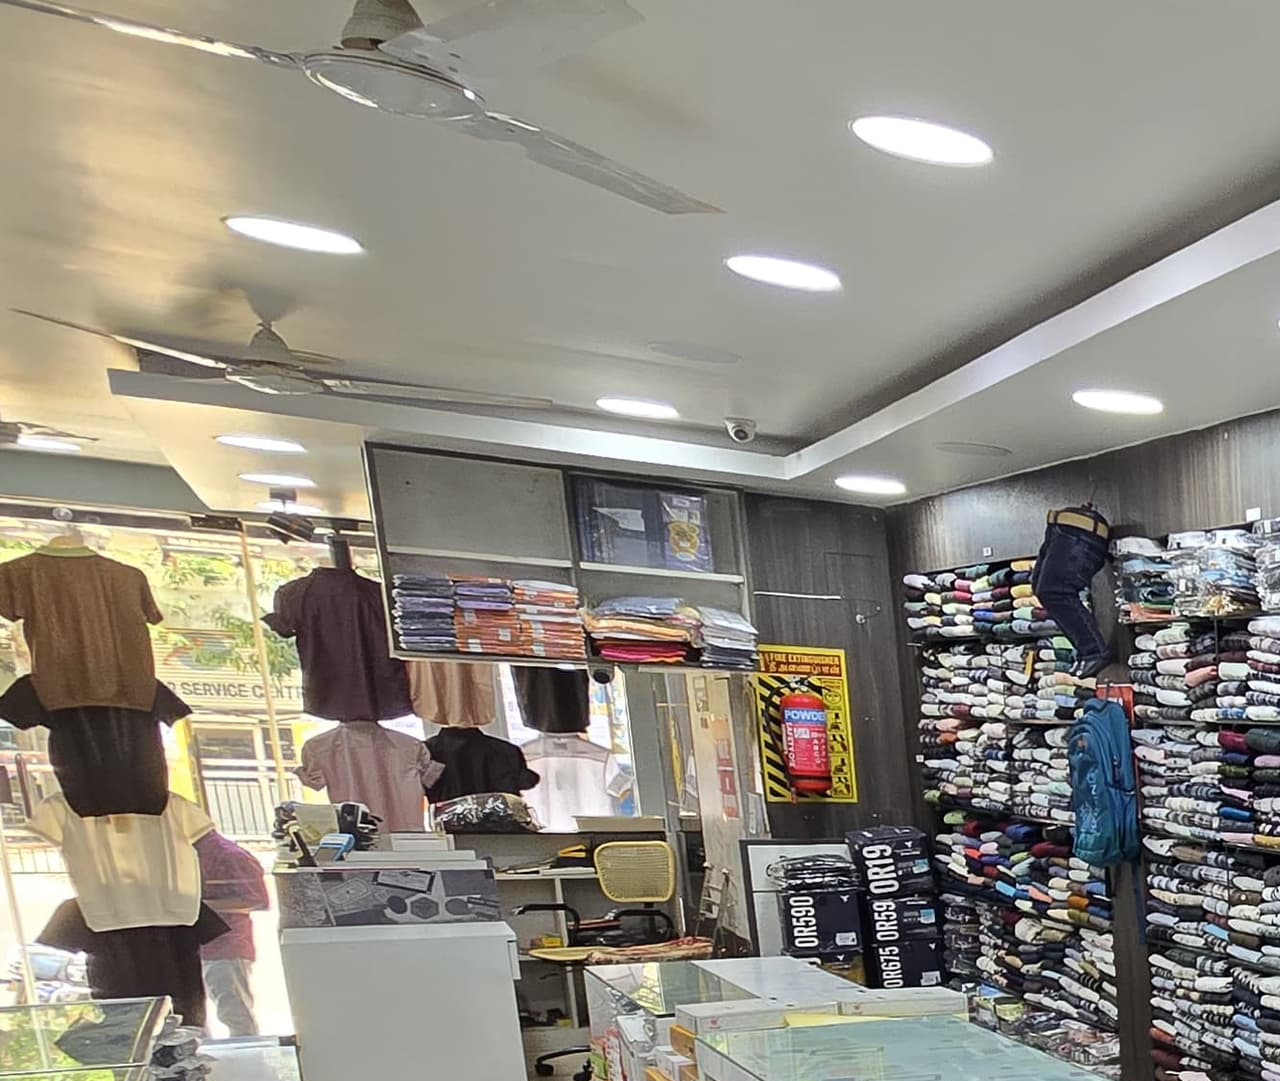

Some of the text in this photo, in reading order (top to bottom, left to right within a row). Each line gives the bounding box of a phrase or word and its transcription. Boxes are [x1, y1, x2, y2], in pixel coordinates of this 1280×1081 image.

[181, 682, 249, 698] SERVICE
[789, 895, 820, 948] OR590
[878, 946, 904, 989] OR675
